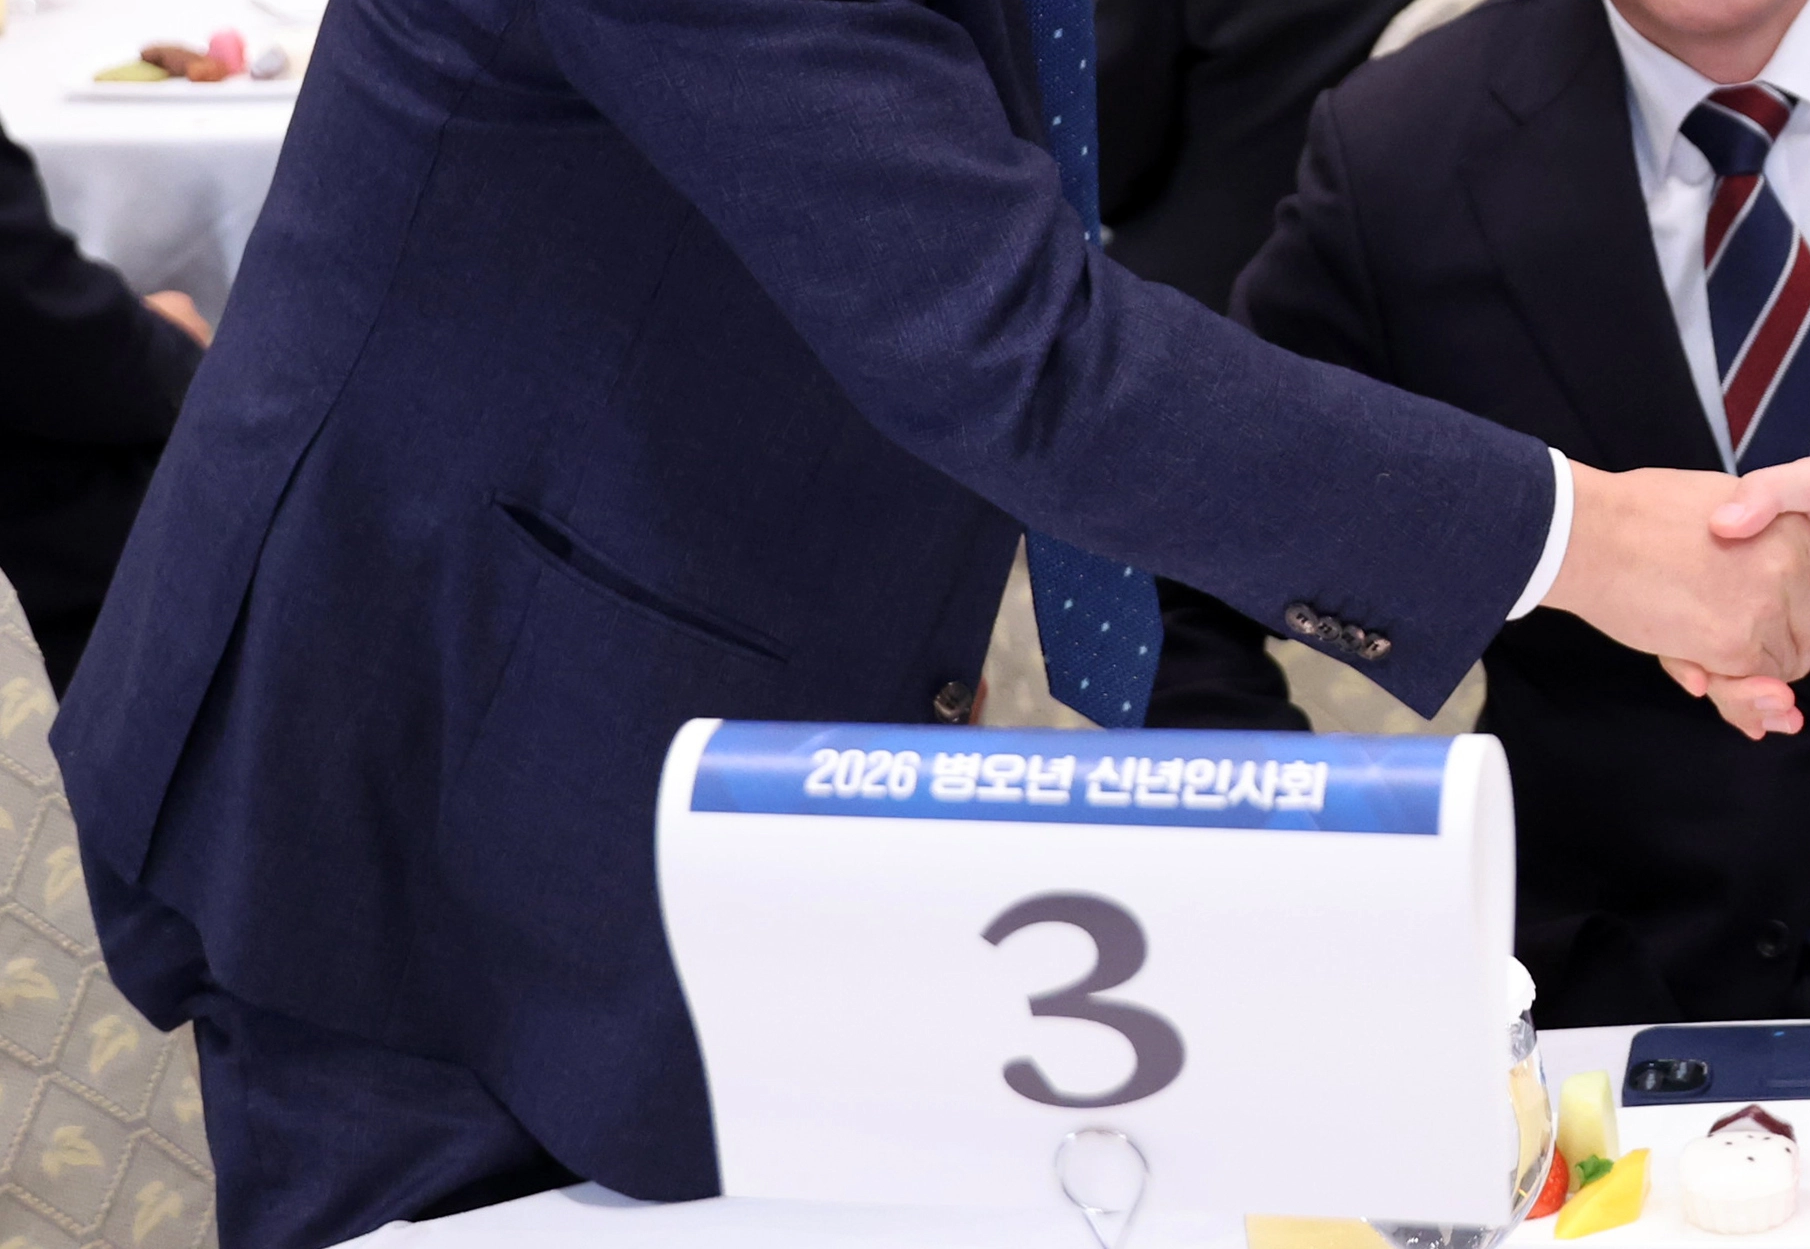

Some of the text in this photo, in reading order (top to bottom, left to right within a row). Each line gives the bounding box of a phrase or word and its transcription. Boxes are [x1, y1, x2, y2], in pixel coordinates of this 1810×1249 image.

[804, 748, 1328, 812] 2026 병오년 신년인사회
[979, 889, 1186, 1108] 3
